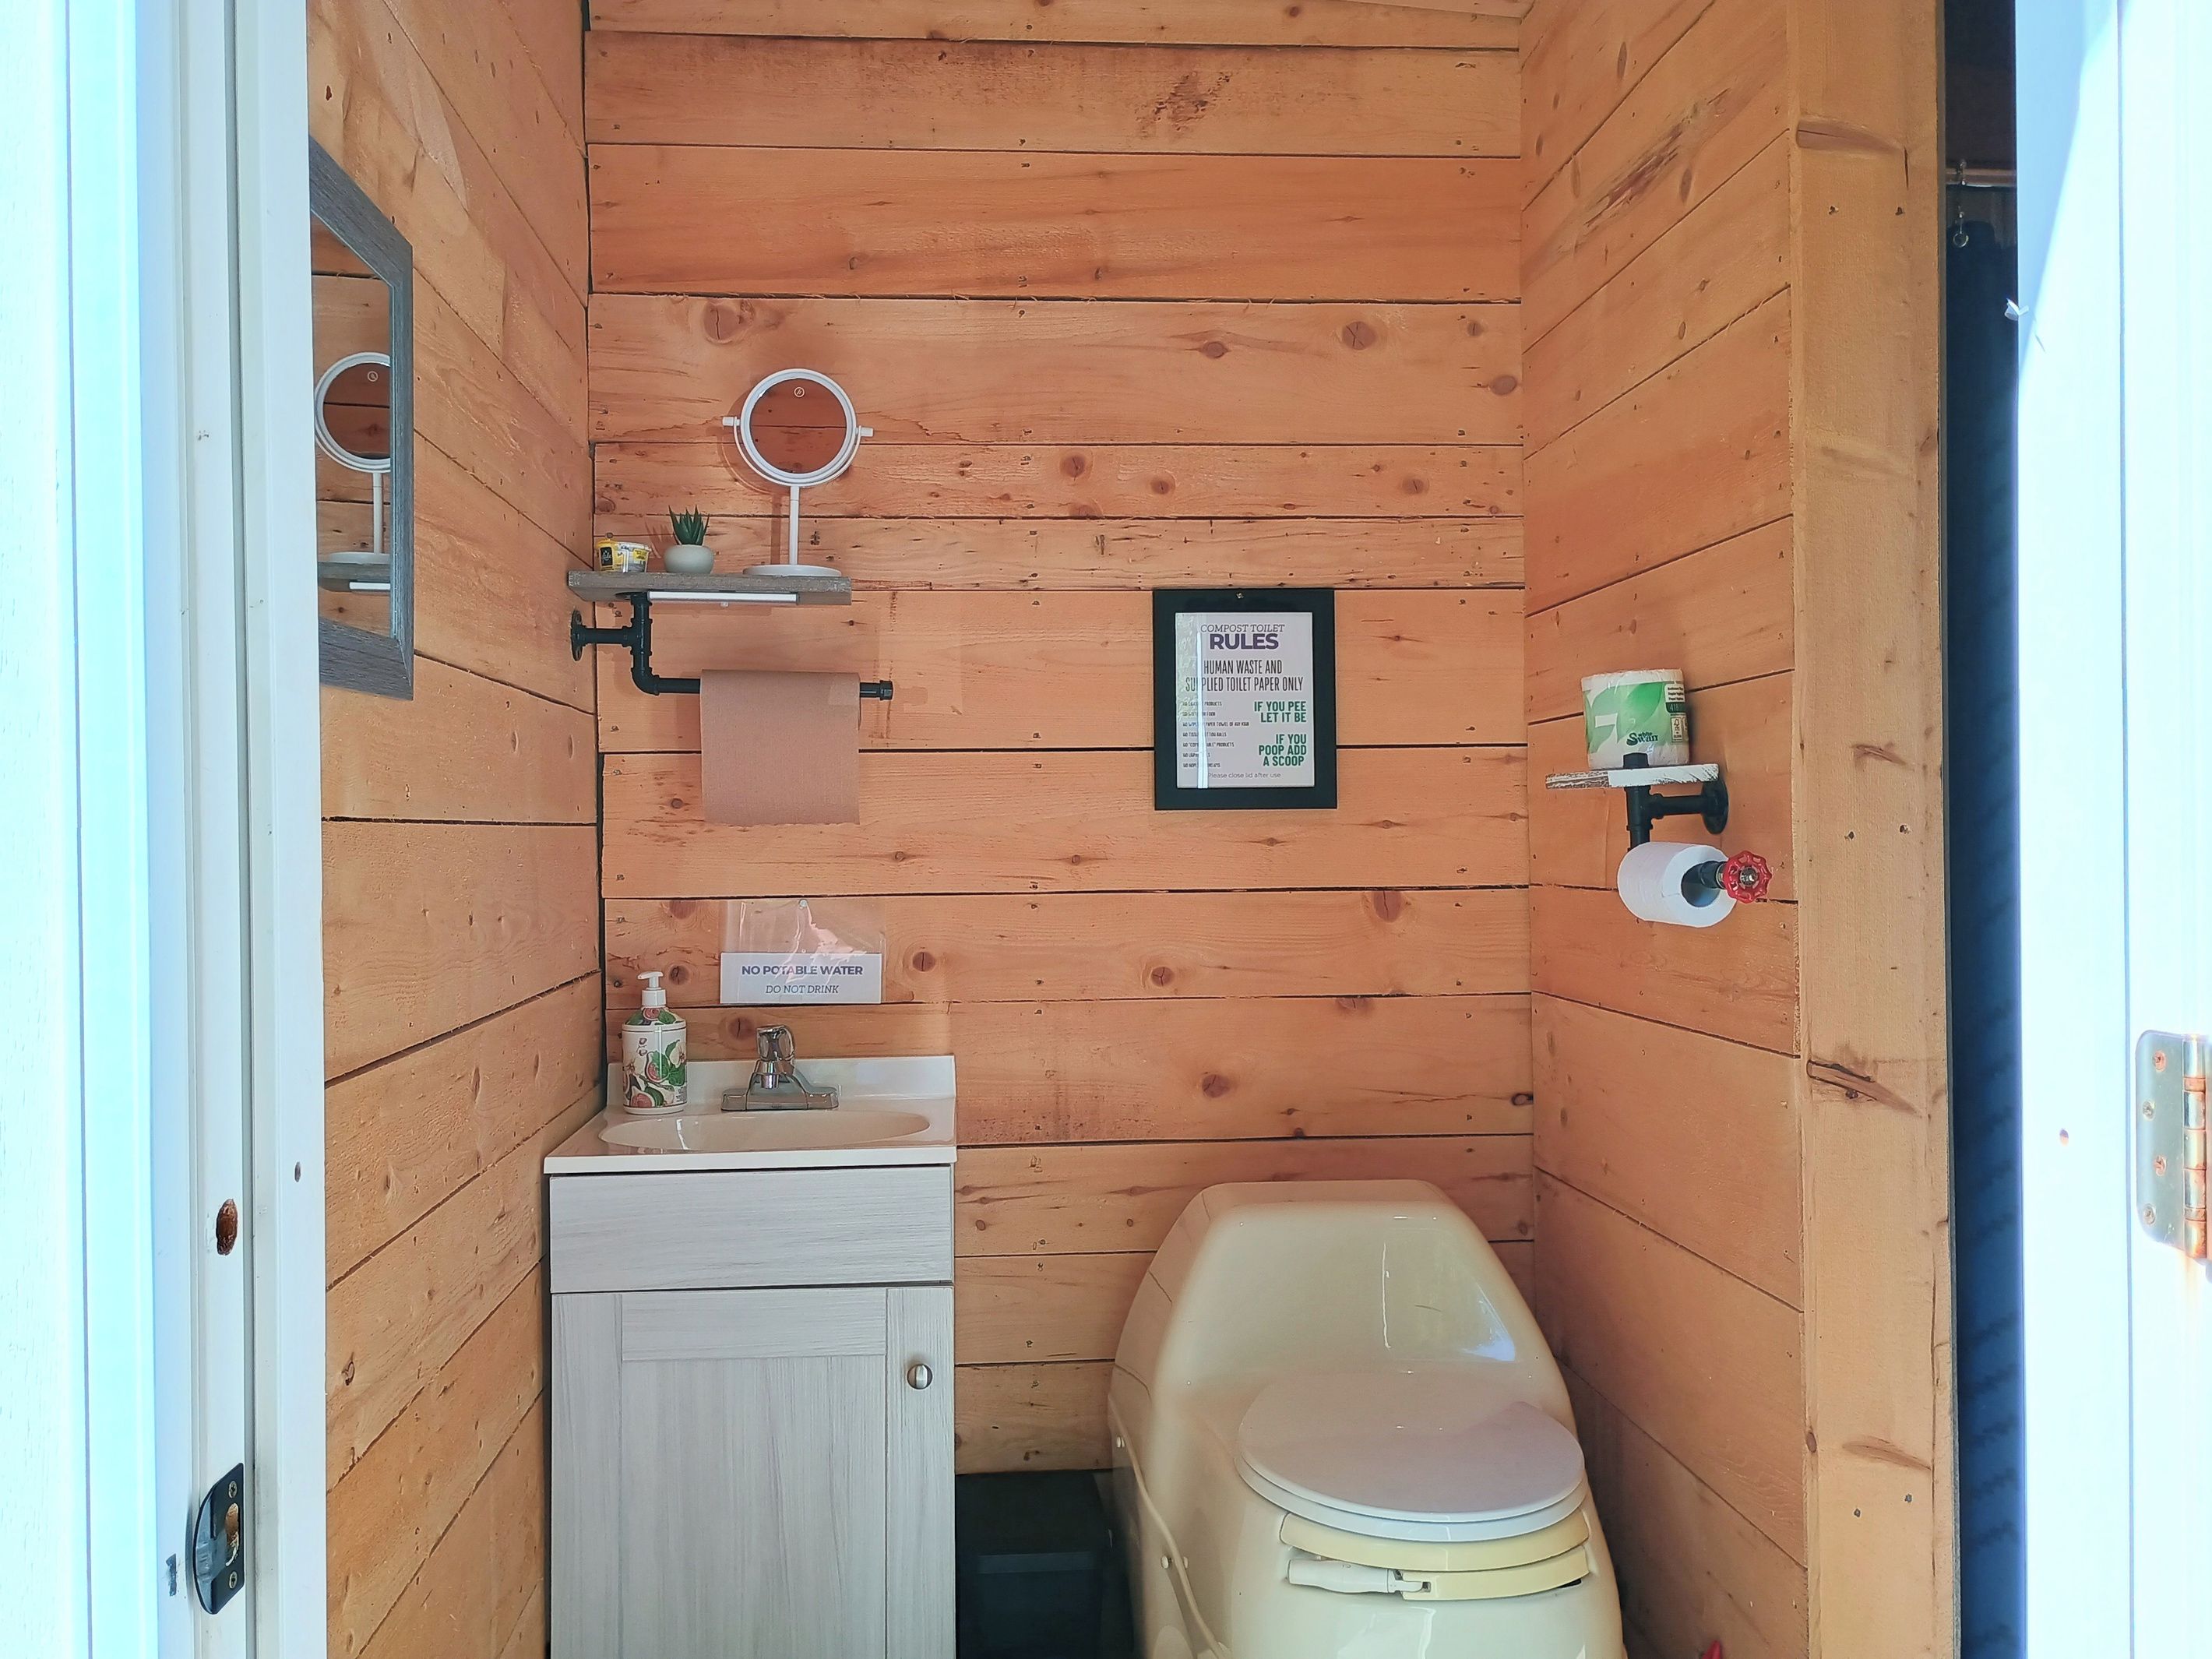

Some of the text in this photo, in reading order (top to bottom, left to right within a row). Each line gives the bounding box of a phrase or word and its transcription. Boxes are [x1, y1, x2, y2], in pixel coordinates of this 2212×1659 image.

[1200, 624, 1285, 632] COMPOST TOILET
[1210, 633, 1279, 650] RULES
[1204, 660, 1282, 675] HUMAN WASTE AND
[1226, 677, 1251, 692] TOILET
[1254, 677, 1280, 692] PAPER
[1282, 677, 1303, 692] ONLY
[1254, 701, 1306, 712] IF YOU PEE
[1260, 712, 1307, 723] LET IT BE
[1276, 734, 1307, 745] IF YOU
[1626, 732, 1659, 746] Swan
[1259, 745, 1307, 756] POOP ADD
[1263, 756, 1305, 766] A SCOOP
[741, 965, 863, 975] NO POTABLE WATER
[766, 984, 840, 994] DO NOT DRINK
